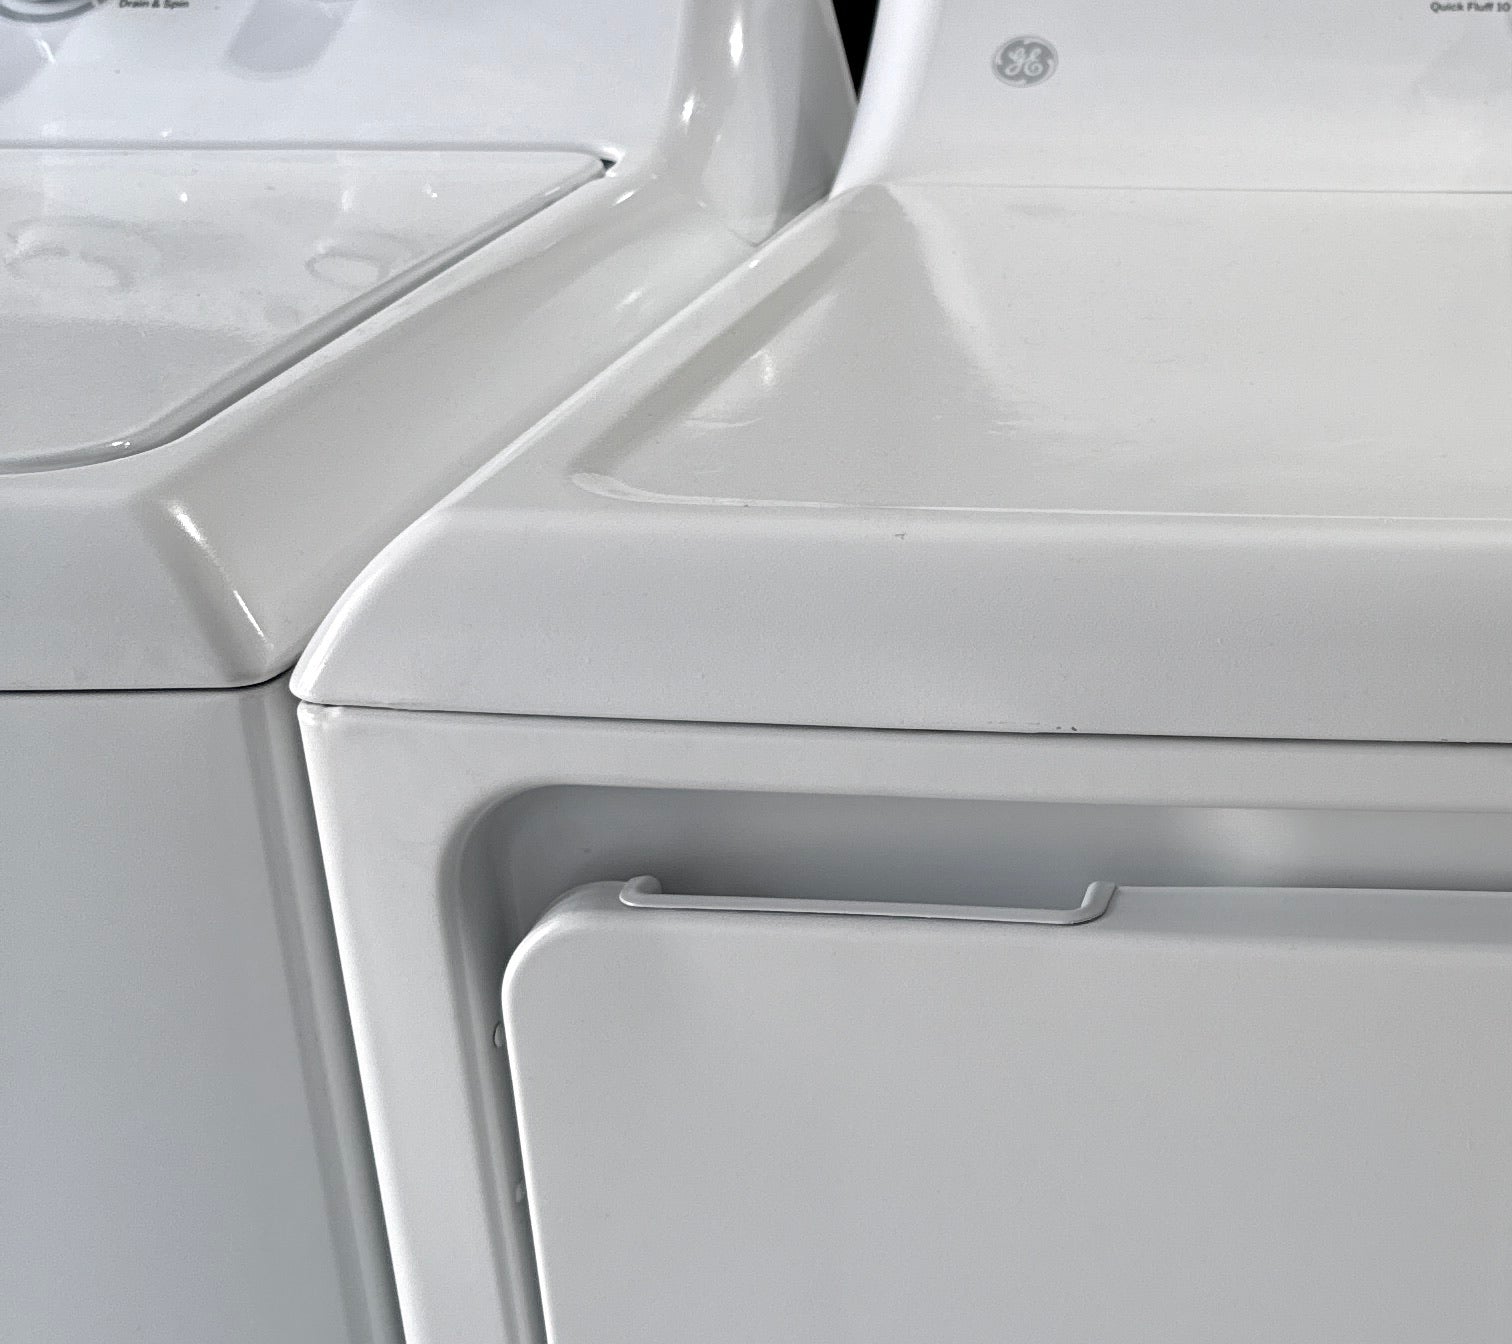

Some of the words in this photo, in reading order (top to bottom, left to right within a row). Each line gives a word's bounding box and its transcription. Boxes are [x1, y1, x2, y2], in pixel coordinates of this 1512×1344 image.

[152, 0, 160, 8] &
[1430, 1, 1463, 13] Quick
[1466, 2, 1494, 11] Fluff
[1497, 2, 1511, 12] 10
